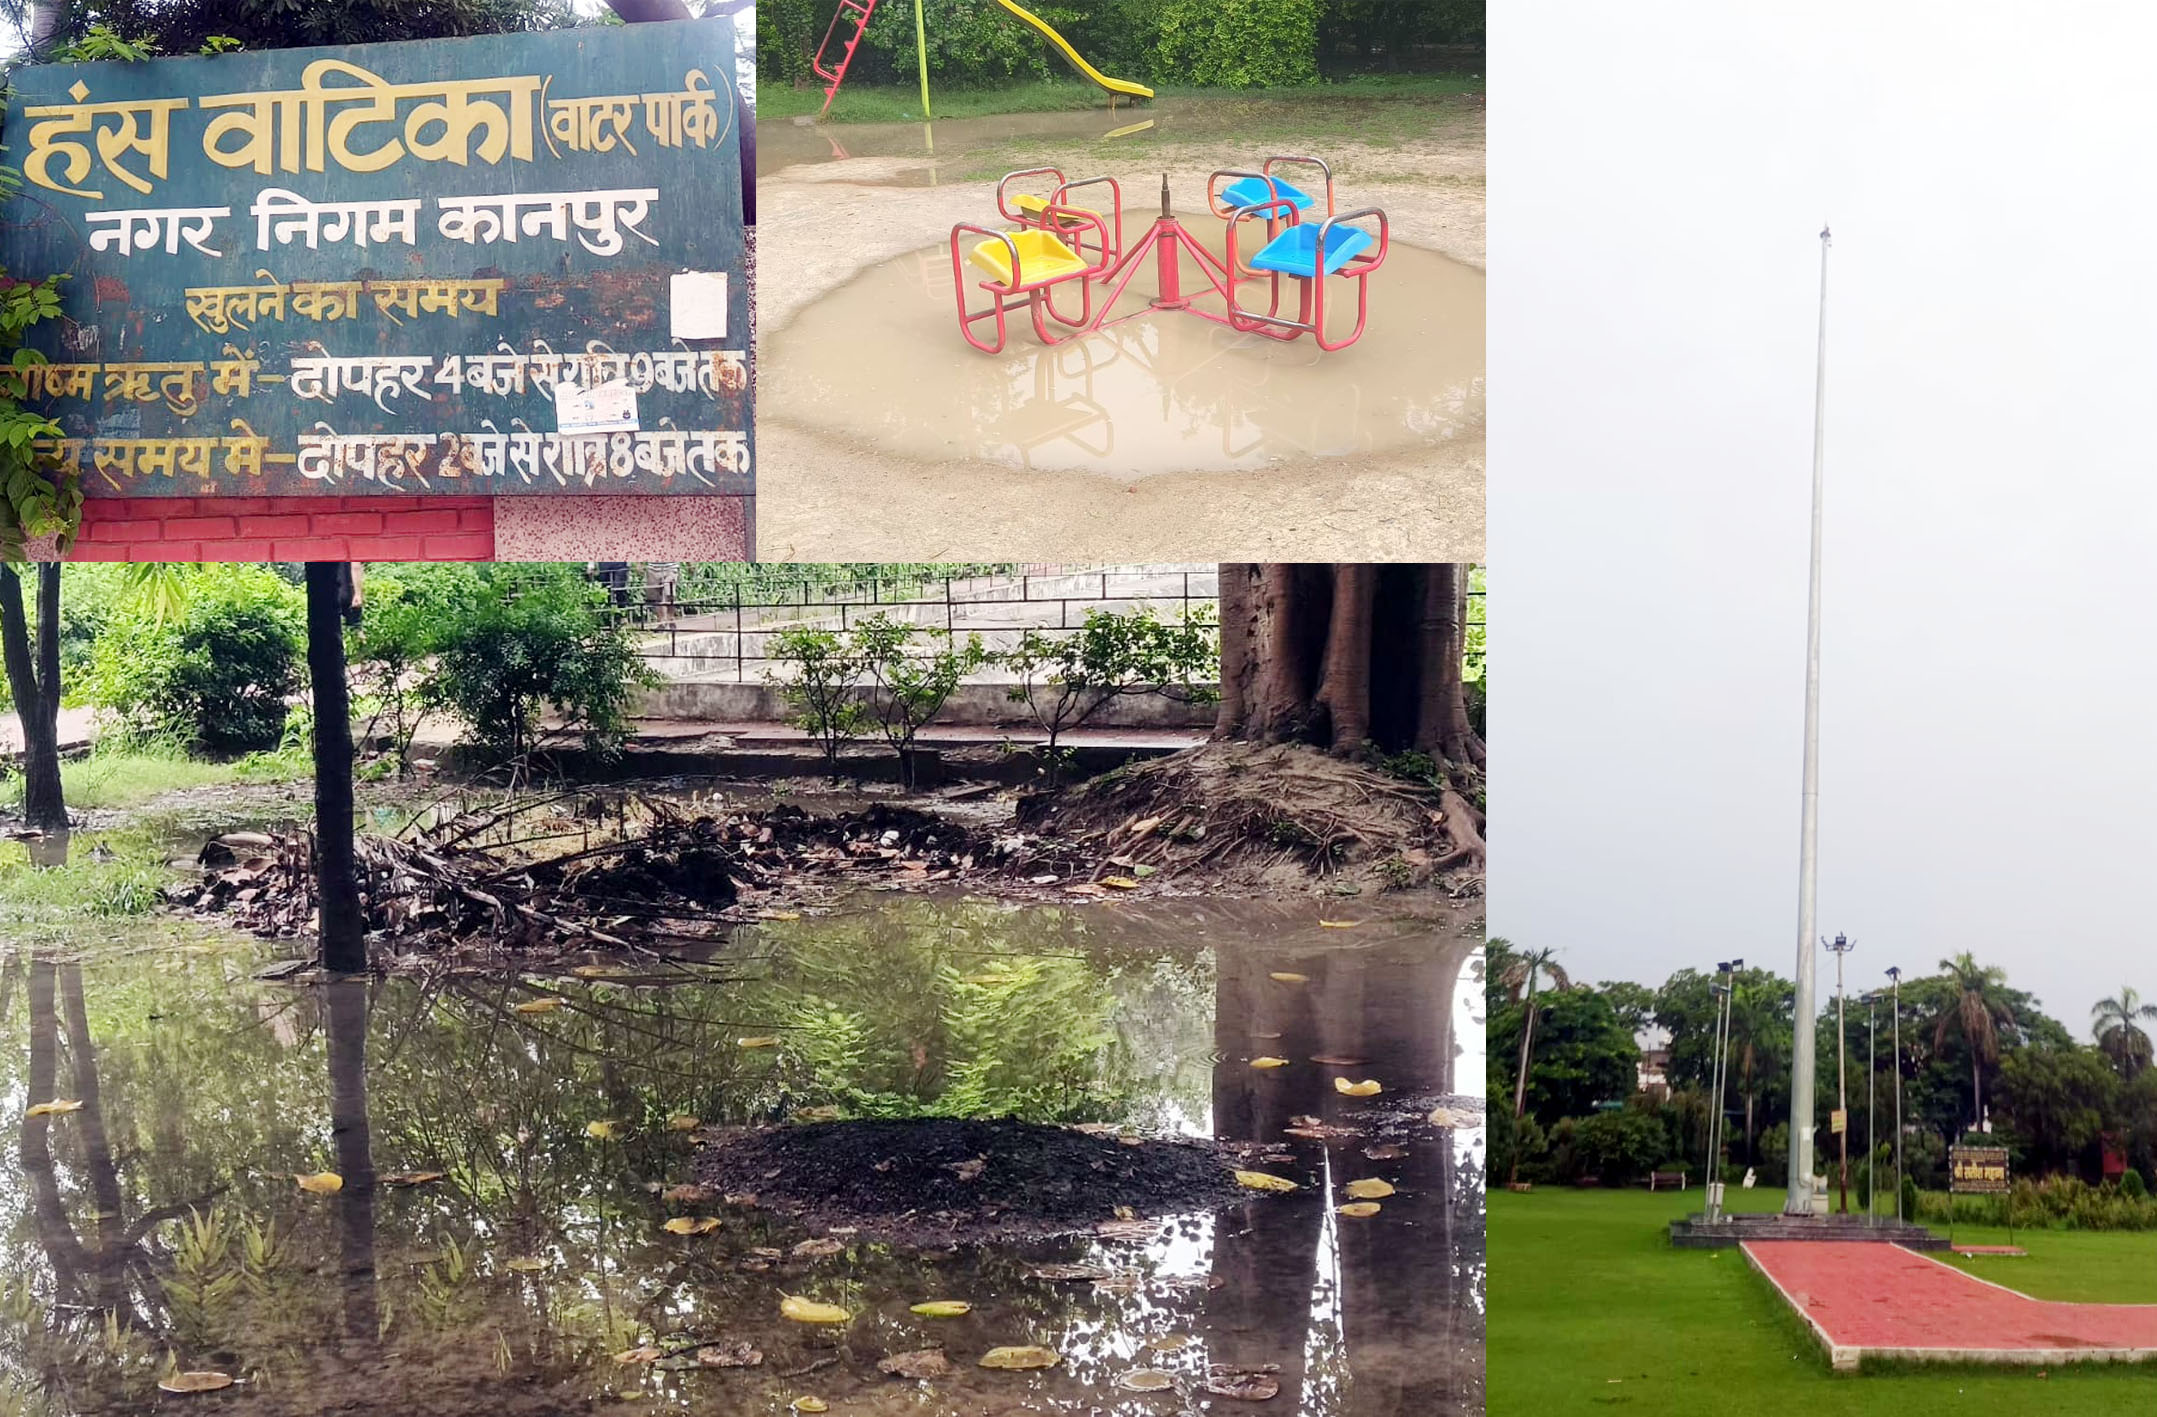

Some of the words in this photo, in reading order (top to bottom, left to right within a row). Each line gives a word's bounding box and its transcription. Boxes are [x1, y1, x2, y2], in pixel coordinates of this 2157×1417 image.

[23, 79, 190, 200] हंस
[199, 58, 542, 176] वाटिका
[540, 74, 642, 160] (वाटर
[641, 64, 734, 150] पार्क)
[85, 206, 231, 258] नगर
[250, 187, 422, 251] निगम
[437, 188, 660, 258] कानपुर
[184, 268, 290, 335] खुलने
[291, 280, 363, 322] का
[367, 278, 504, 327] समय
[103, 361, 206, 417] ऋतु
[290, 340, 433, 416] दोपहर
[433, 353, 465, 395] 4
[465, 342, 530, 400] बजे
[529, 339, 561, 401] से
[630, 351, 654, 394] 9
[652, 337, 699, 394] बजे
[697, 350, 748, 401] तक
[93, 436, 219, 492] समय
[297, 421, 437, 492] दोपहर
[437, 431, 461, 478] 2
[459, 419, 510, 477] बजे
[509, 417, 544, 485] से
[609, 431, 635, 478] 8
[634, 416, 690, 478] बजे
[686, 430, 751, 488] तक
